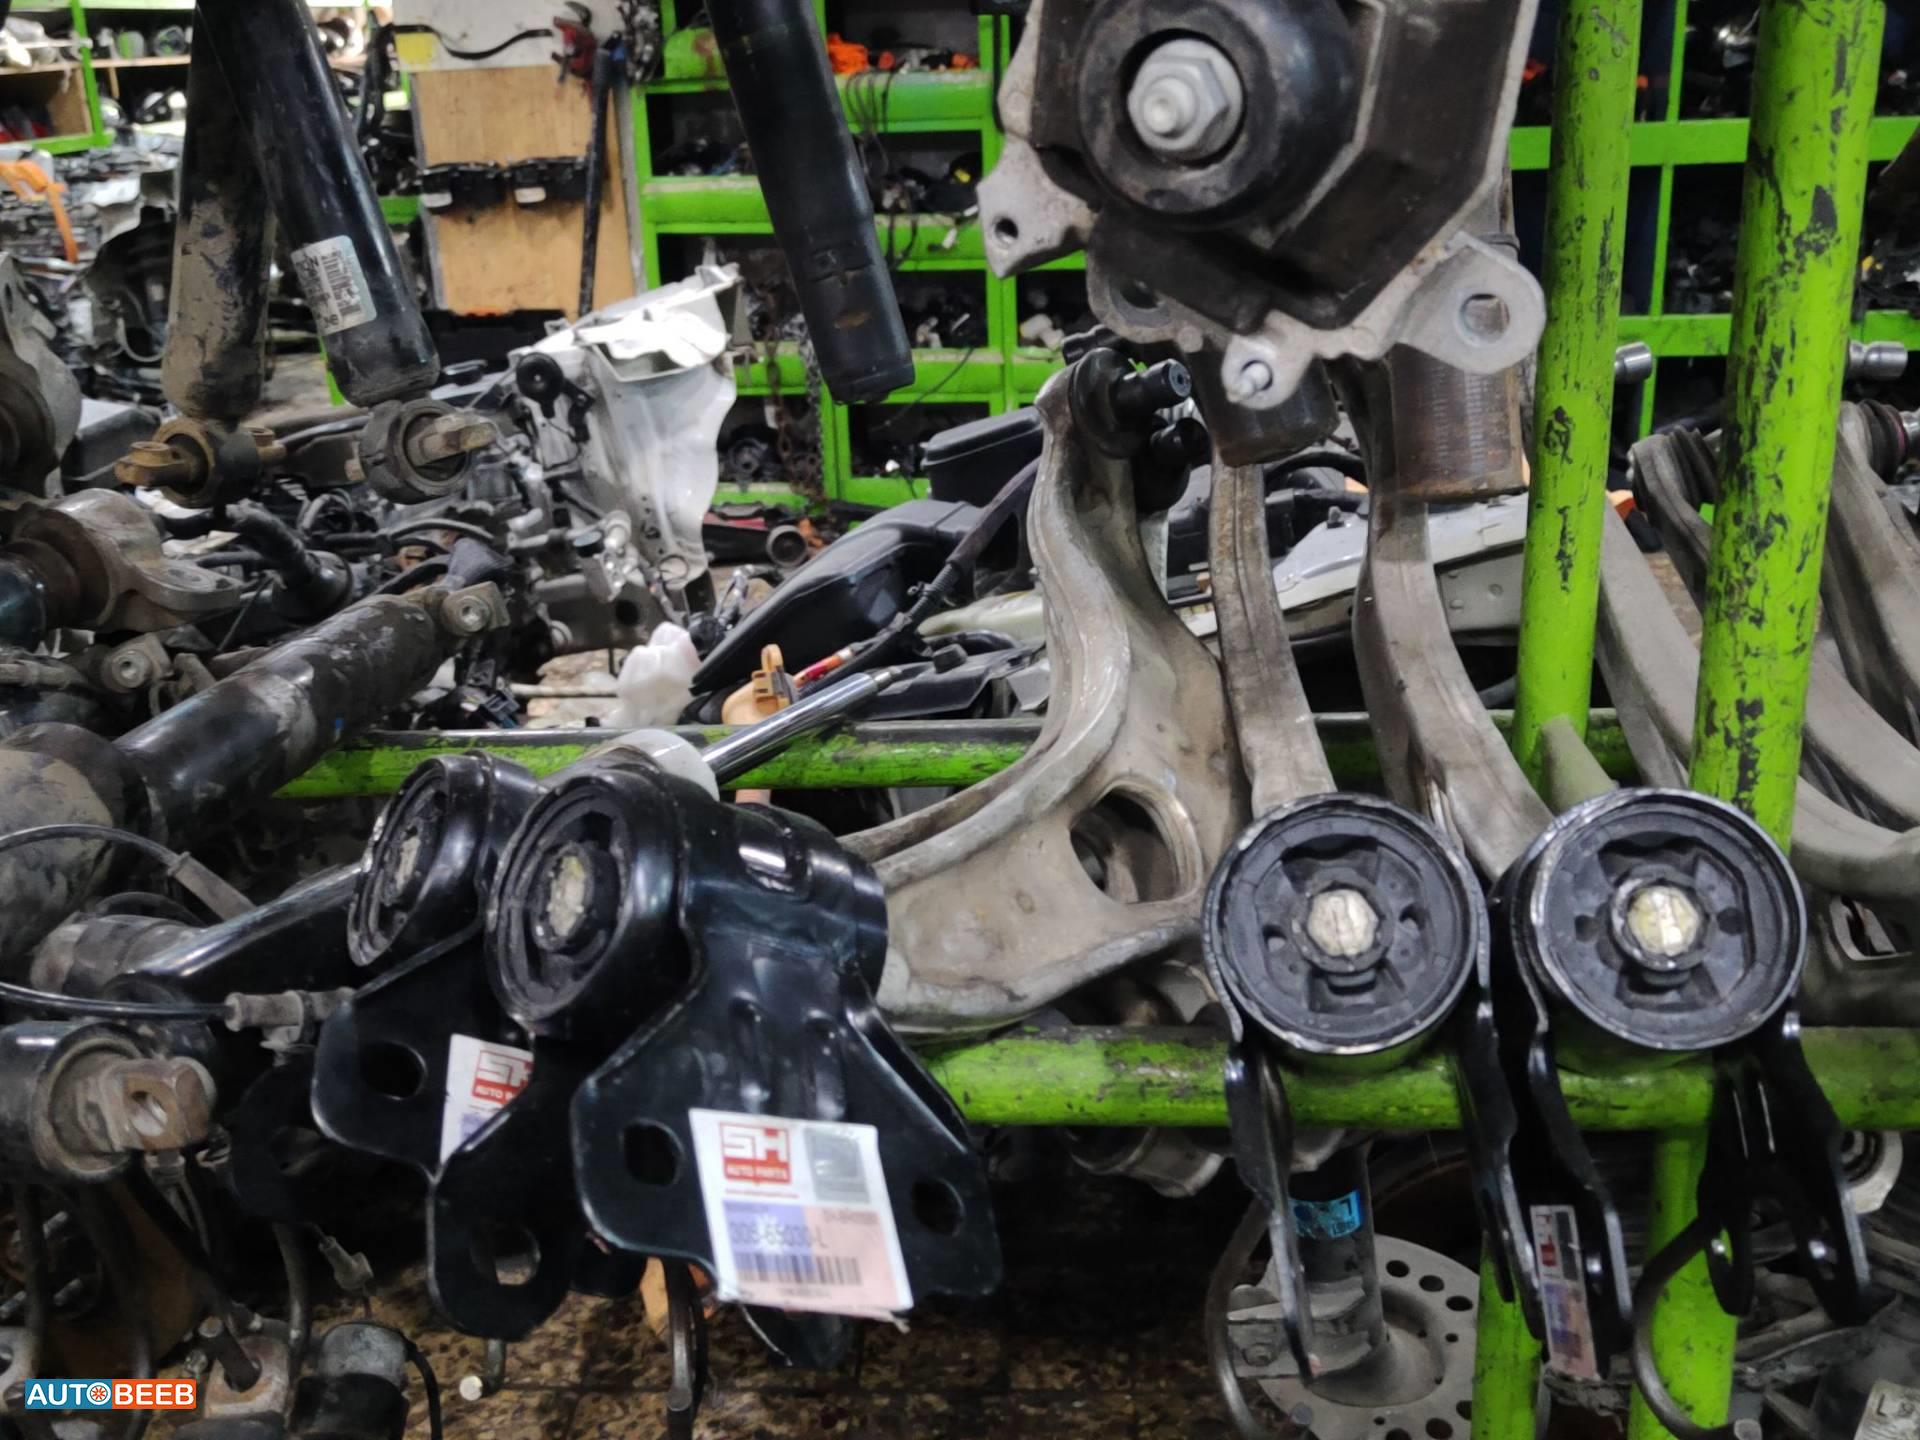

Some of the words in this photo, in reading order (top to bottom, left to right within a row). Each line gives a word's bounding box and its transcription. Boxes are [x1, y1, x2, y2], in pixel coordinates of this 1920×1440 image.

[722, 1125, 789, 1162] SH
[726, 1165, 754, 1177] AUTO
[756, 1168, 788, 1180] PARTS
